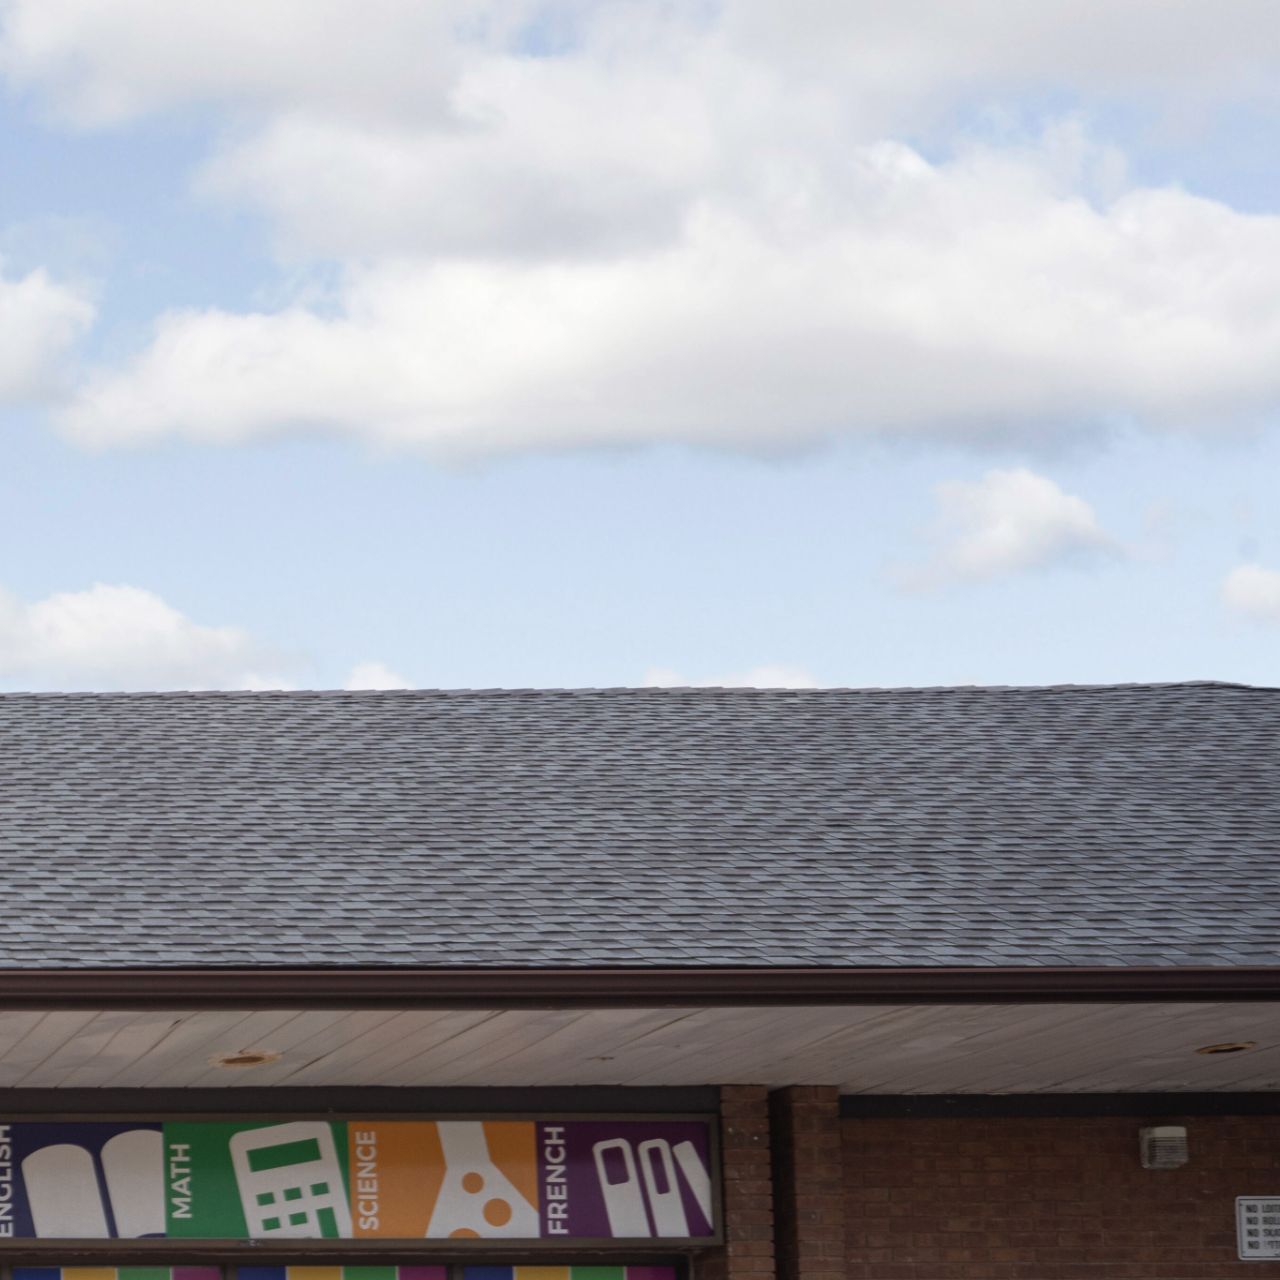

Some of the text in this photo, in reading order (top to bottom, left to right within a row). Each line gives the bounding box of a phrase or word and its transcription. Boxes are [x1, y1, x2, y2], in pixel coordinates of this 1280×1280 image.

[171, 1144, 193, 1219] MATH
[354, 1131, 378, 1231] SCIENCE
[544, 1126, 568, 1234] FRENCH
